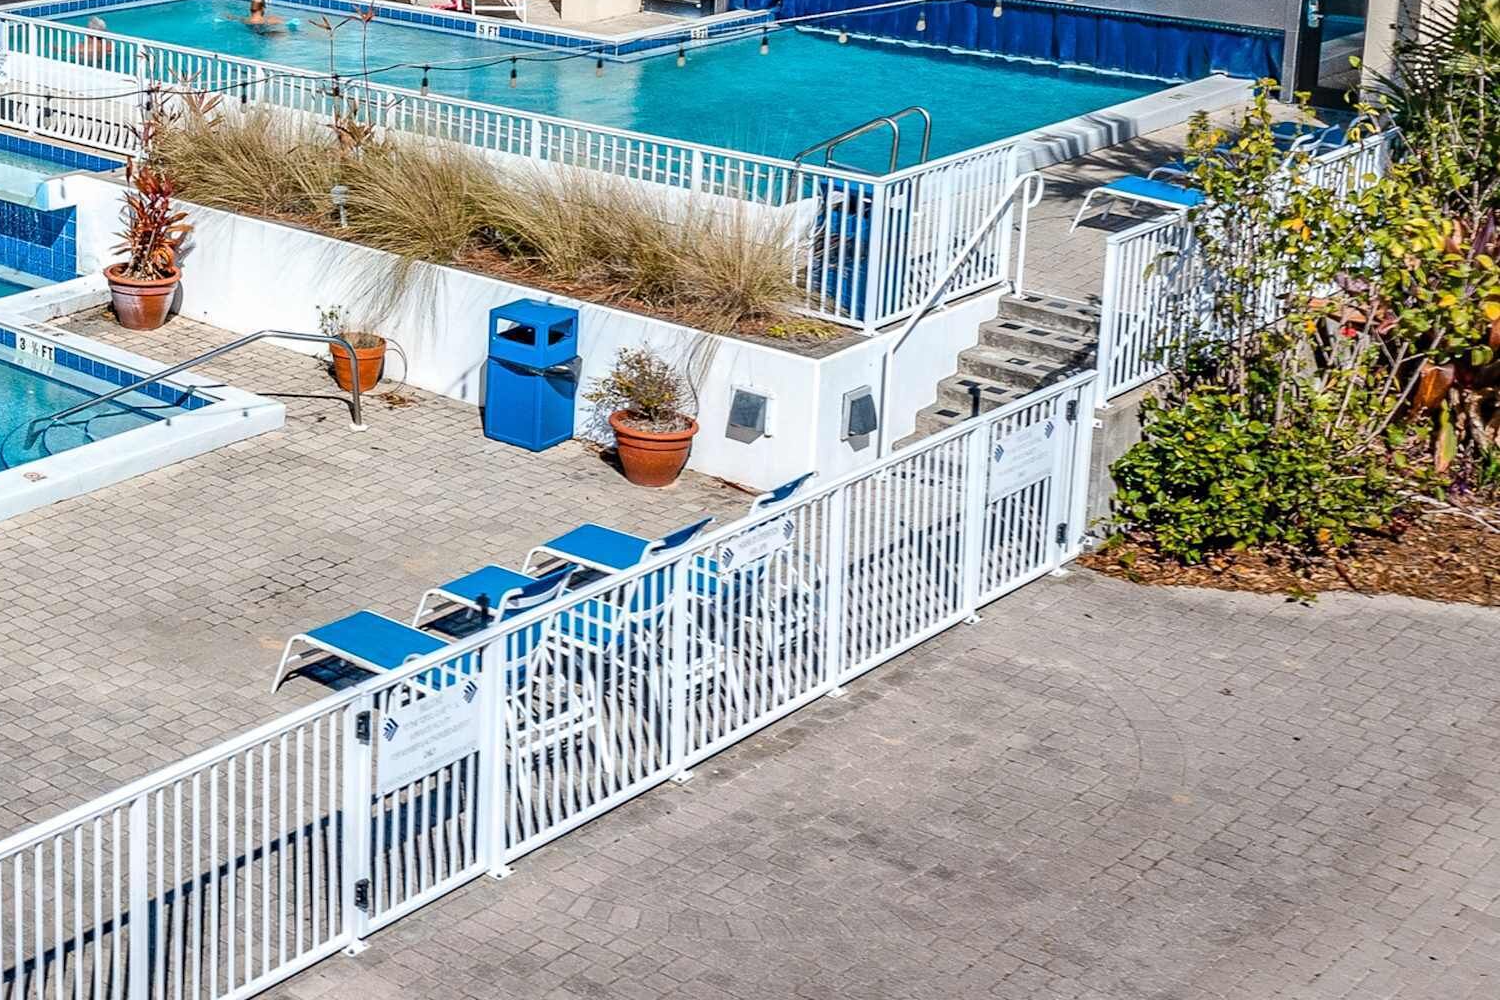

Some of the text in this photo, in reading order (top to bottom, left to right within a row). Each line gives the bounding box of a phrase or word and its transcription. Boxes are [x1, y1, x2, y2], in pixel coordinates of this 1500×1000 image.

[479, 24, 498, 37] 5 FT
[20, 337, 26, 350] 3
[41, 345, 53, 361] FT
